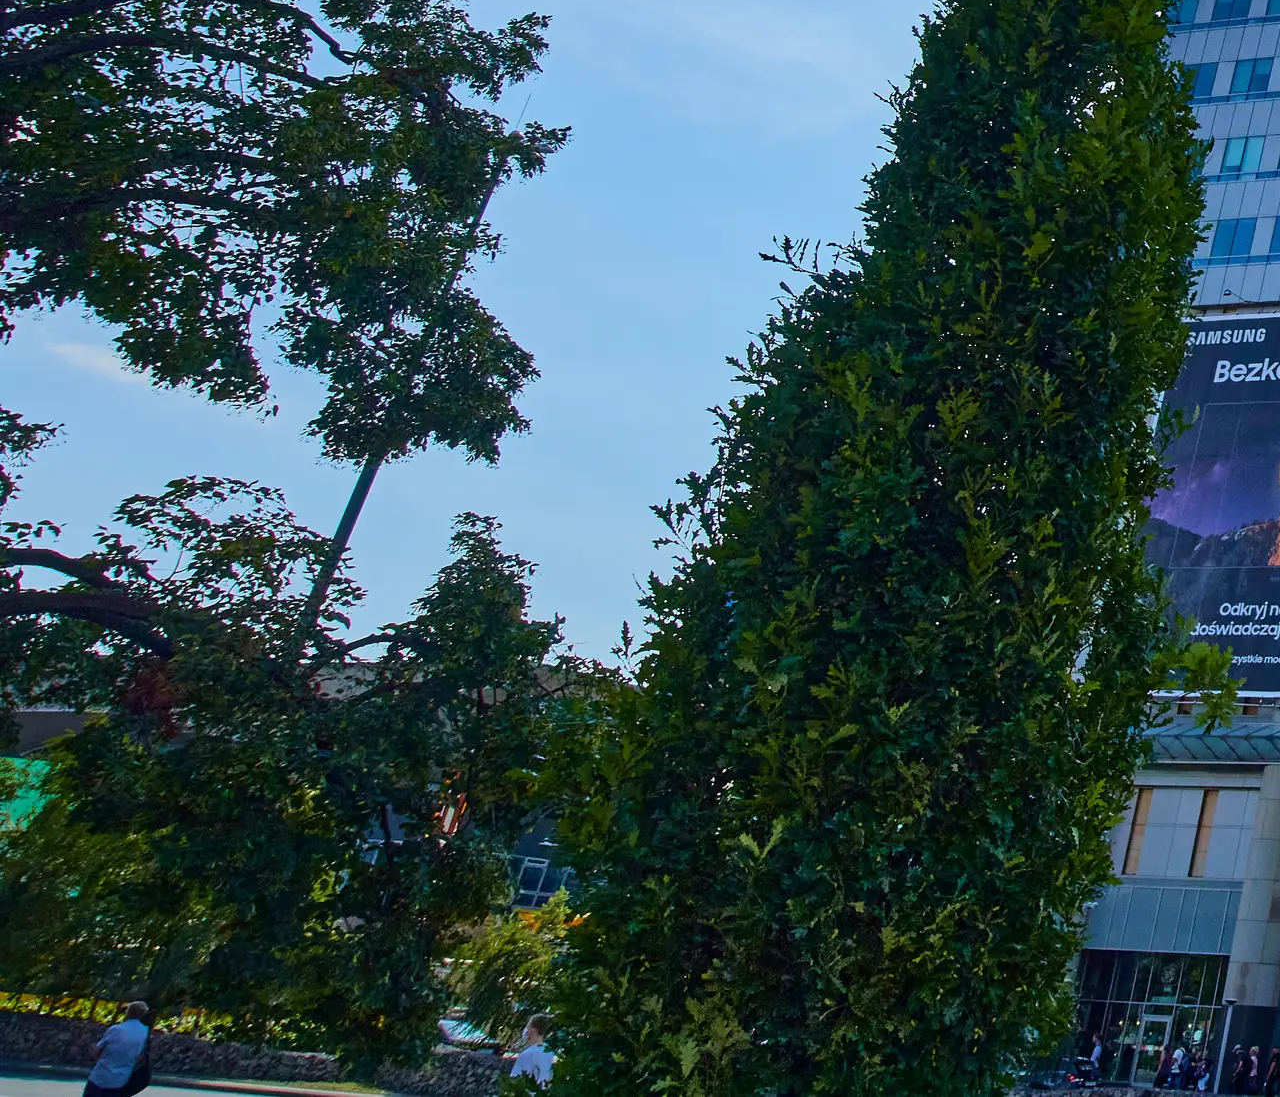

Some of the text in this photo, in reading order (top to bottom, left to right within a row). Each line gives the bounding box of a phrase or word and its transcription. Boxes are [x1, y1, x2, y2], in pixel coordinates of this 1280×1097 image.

[1185, 328, 1267, 345] SAMSUNG
[1219, 602, 1268, 620] Odkryj
[1232, 654, 1263, 665] zystkie
